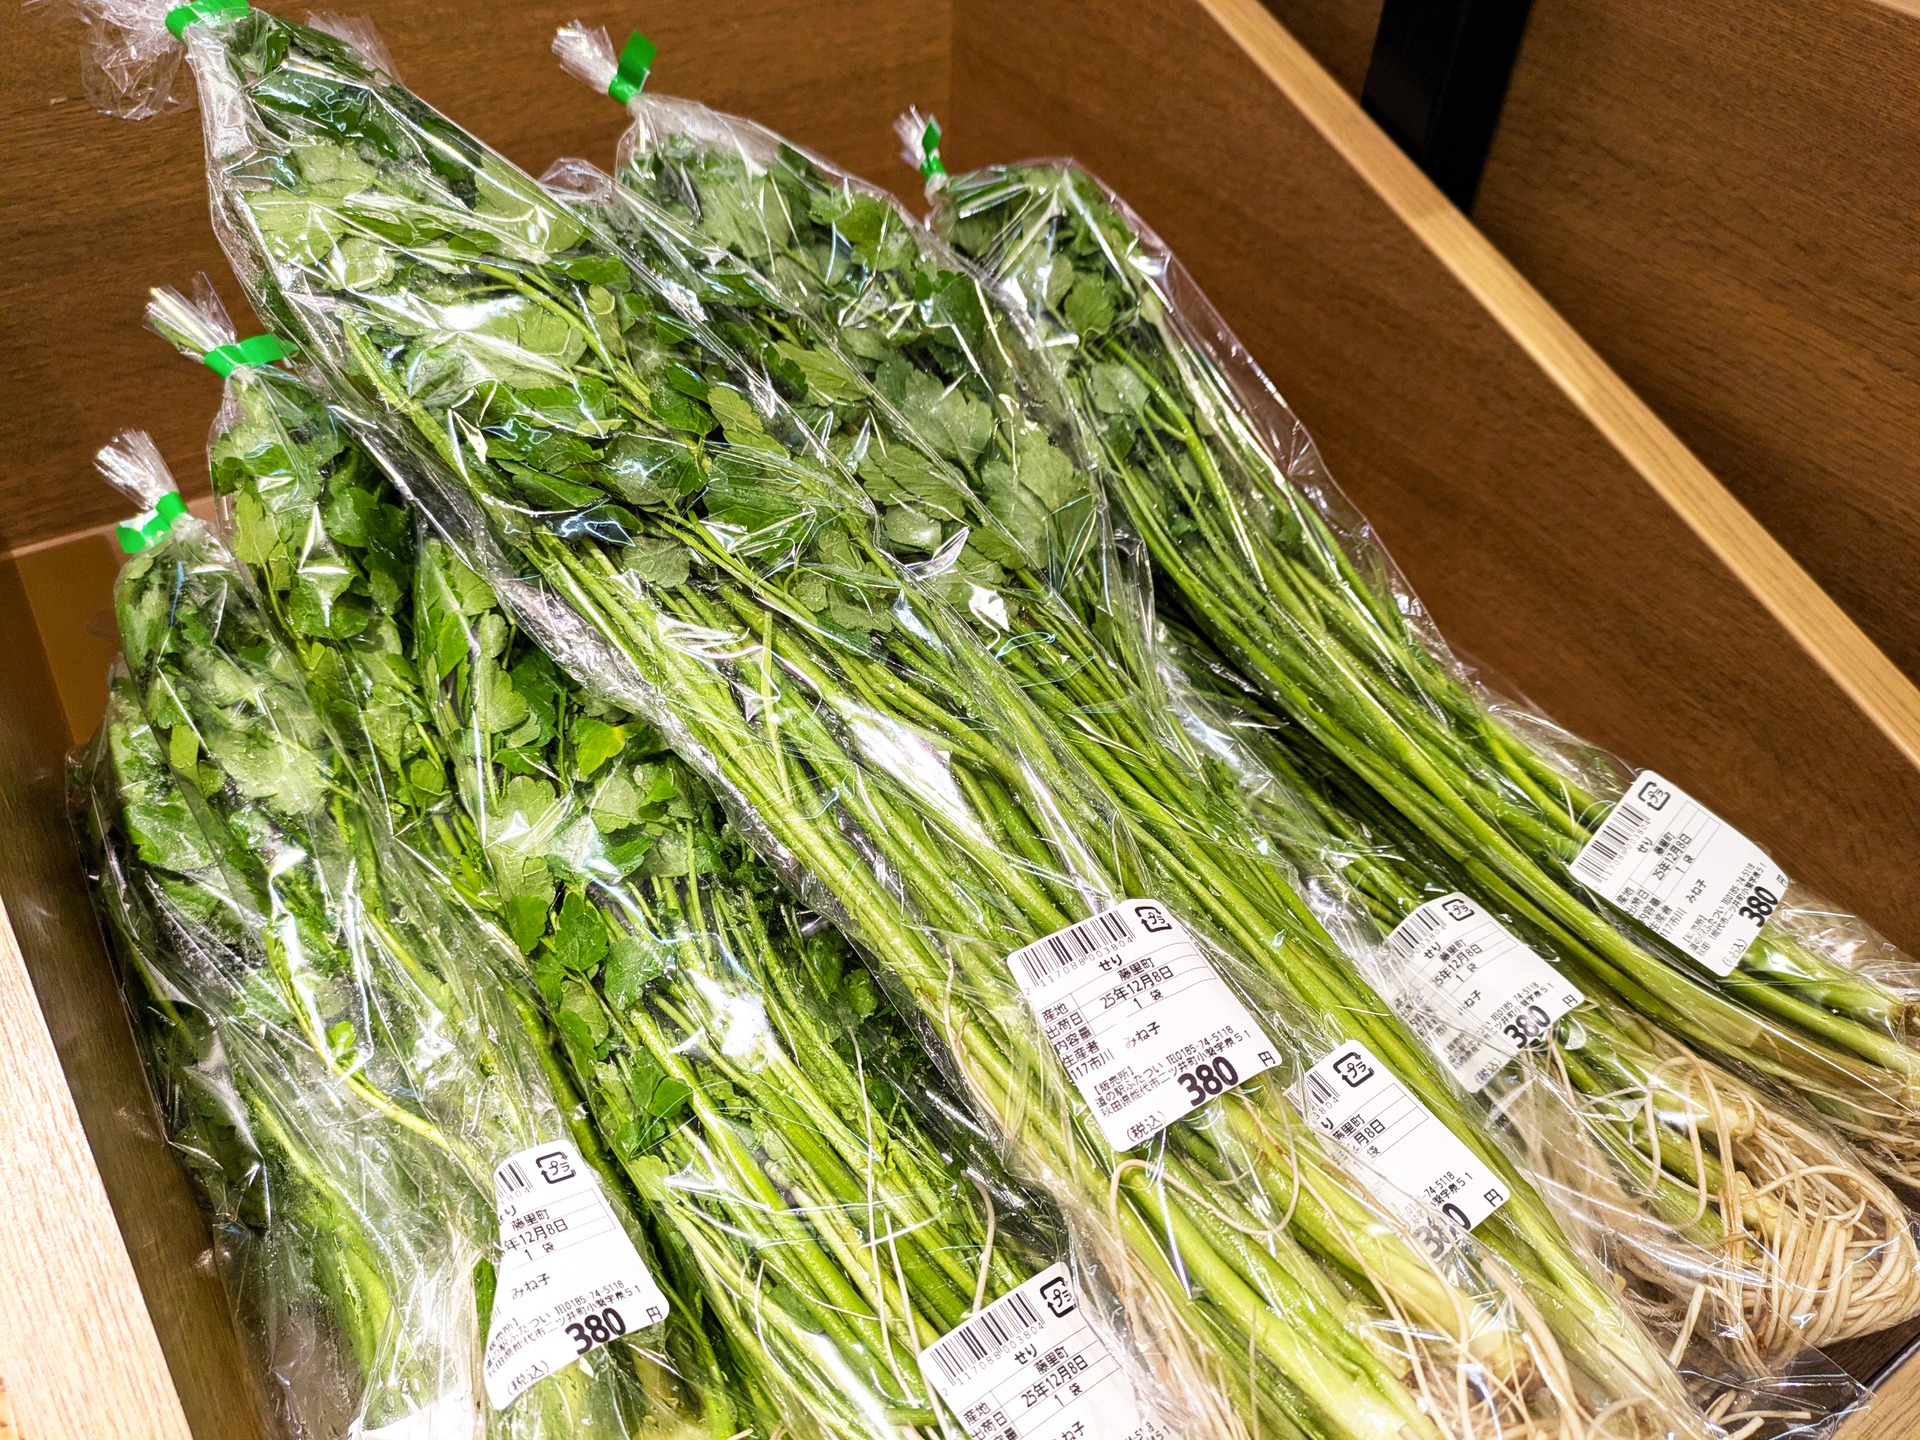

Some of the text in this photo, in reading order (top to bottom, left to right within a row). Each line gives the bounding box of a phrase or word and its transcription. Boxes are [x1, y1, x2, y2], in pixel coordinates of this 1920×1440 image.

[1636, 838, 1653, 854] せり
[1652, 833, 1692, 881] 25年12月8日
[1616, 831, 1676, 906] 産地 藤里町
[1685, 878, 1707, 904] みね子
[1650, 905, 1674, 934] 生産者
[1738, 885, 1779, 929] 380
[1098, 953, 1124, 972] せり
[1423, 941, 1442, 960] せり
[1439, 938, 1468, 964] 藤里町
[1041, 957, 1156, 1024] 産地 藤里町
[1045, 965, 1175, 1041] 出荷日 25年12月8日
[1503, 1004, 1551, 1050] 380
[1561, 994, 1579, 1008] 円
[1054, 1025, 1092, 1053] 内容量
[1070, 1020, 1161, 1081] 117市川 みね子
[1062, 1039, 1100, 1069] 生産者
[1126, 1050, 1277, 1143] (税込) 380 円
[1483, 1188, 1504, 1208] 円
[511, 1208, 551, 1232] 藤里町
[510, 1272, 551, 1300] みね子
[507, 1305, 663, 1396] (税込) 380 円
[1014, 1342, 1039, 1366] せり
[963, 1345, 1070, 1427] 産地 藤里町
[971, 1353, 1089, 1440] 出荷日 25年12月8日
[1053, 1420, 1086, 1440] ね子
